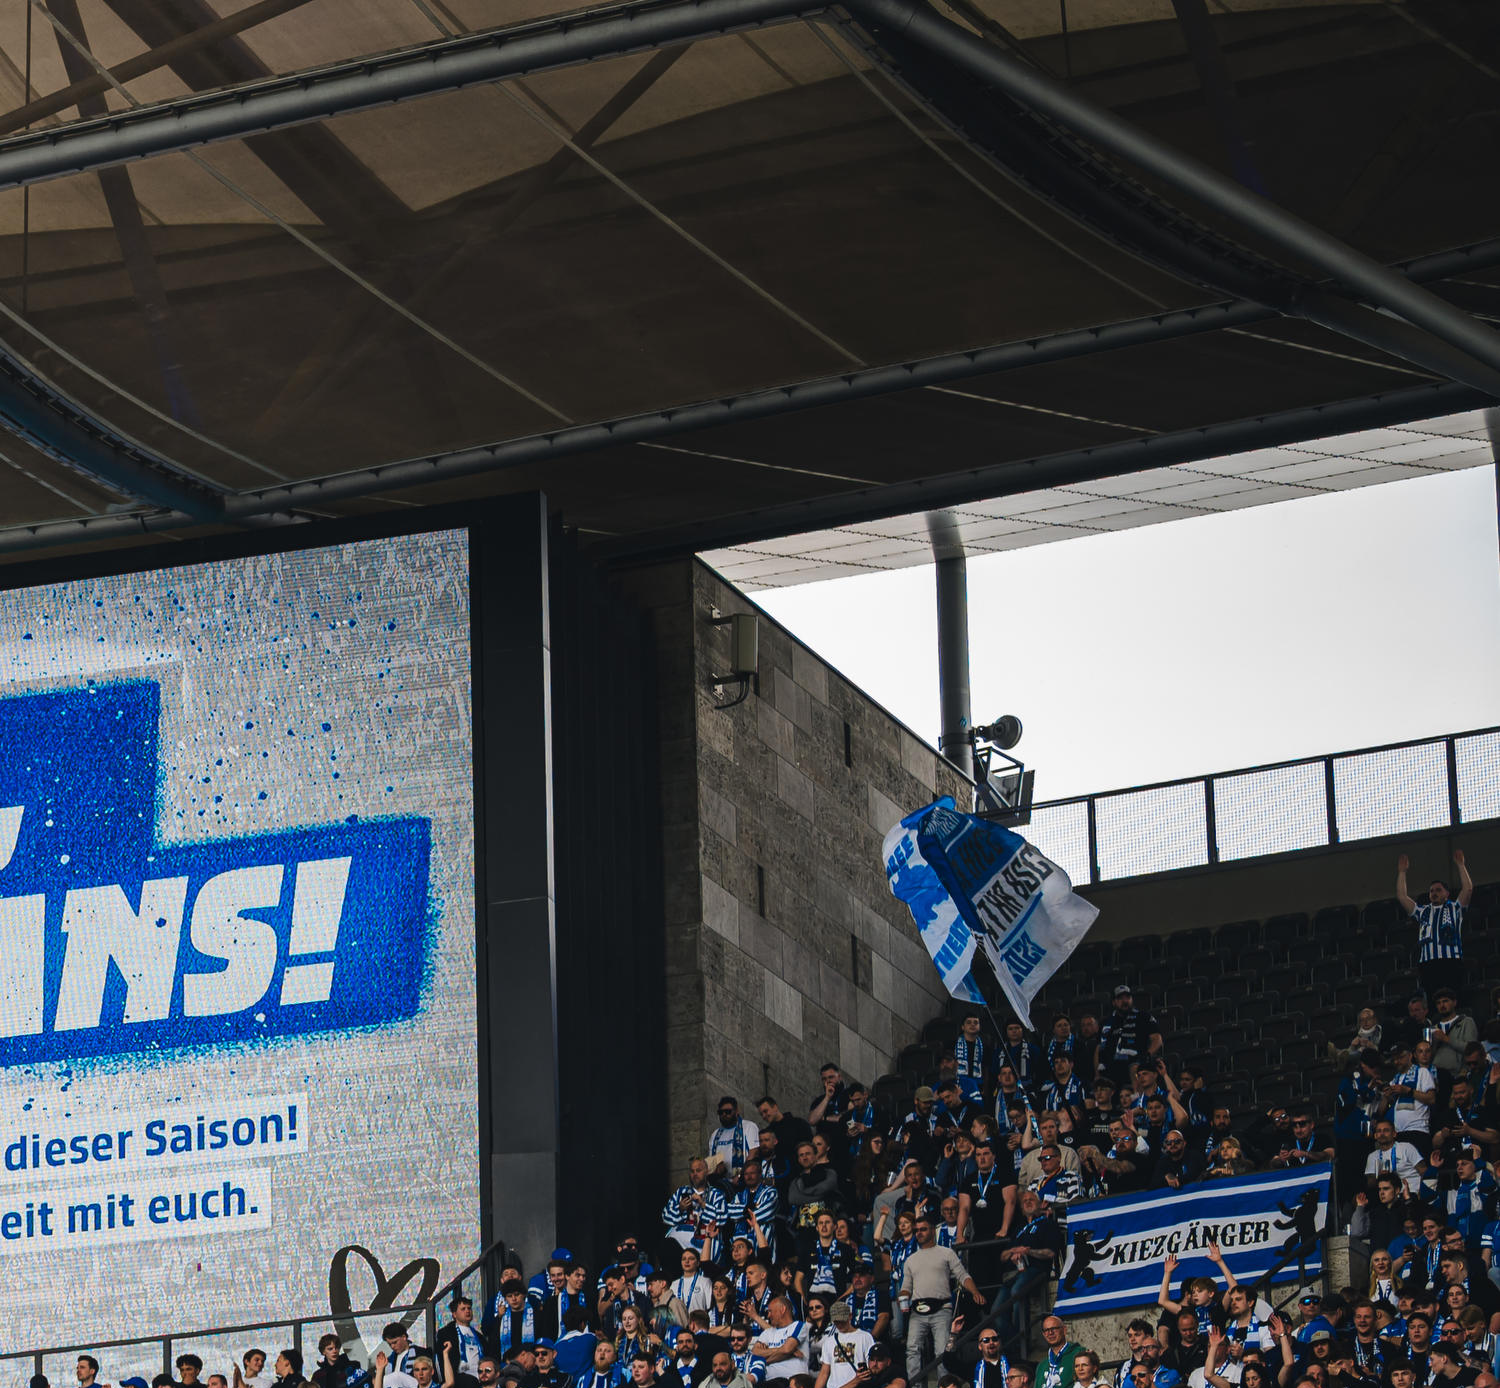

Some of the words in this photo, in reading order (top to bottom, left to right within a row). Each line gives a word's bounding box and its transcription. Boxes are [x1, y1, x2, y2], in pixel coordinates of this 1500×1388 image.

[4, 1130, 134, 1171] dieser
[145, 1105, 299, 1156] Saison!
[67, 1194, 135, 1234] mit
[147, 1181, 257, 1225] euch.
[1110, 1221, 1270, 1265] KIEZGÄNGER
